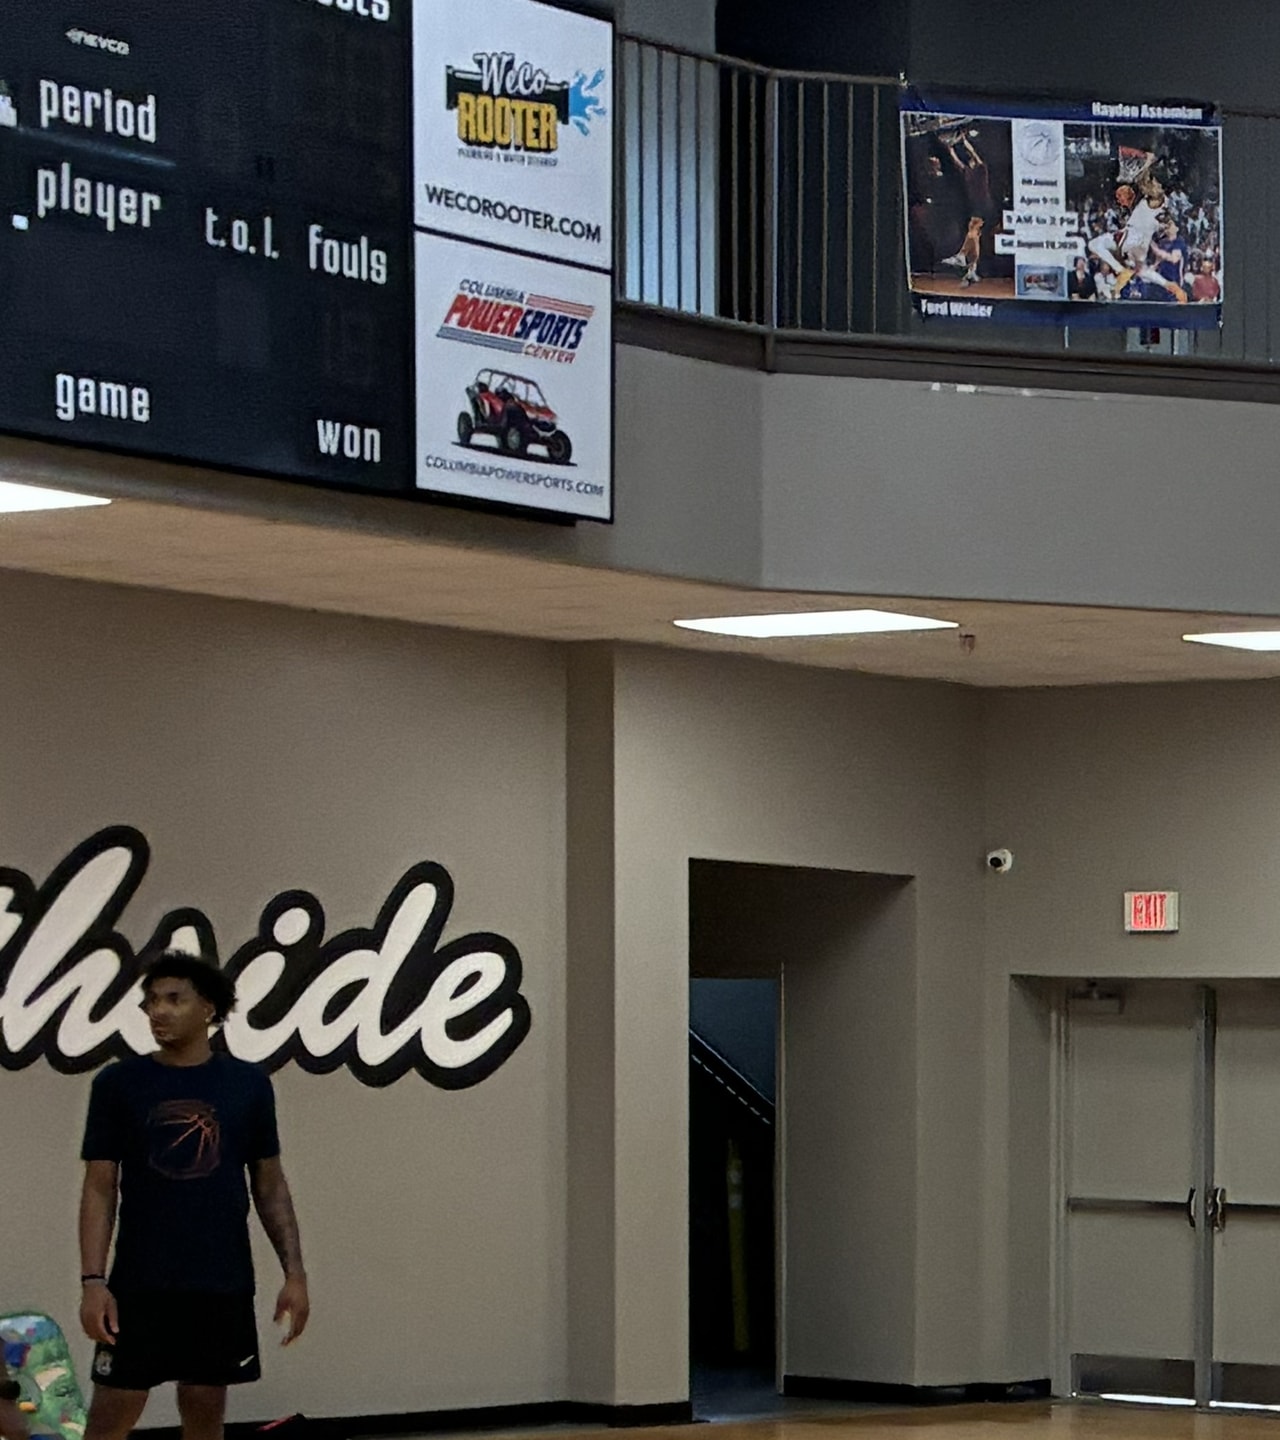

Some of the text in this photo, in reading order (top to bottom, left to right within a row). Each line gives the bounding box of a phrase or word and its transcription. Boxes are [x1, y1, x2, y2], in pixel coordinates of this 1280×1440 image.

[473, 52, 548, 95] WeCo
[39, 79, 156, 144] period
[457, 92, 558, 154] ROOTER
[37, 162, 161, 231] player
[424, 183, 602, 243] WECOROOTER.COM
[205, 206, 388, 285] t.o.l. fouls
[444, 293, 588, 350] POWERSPORTS
[525, 344, 576, 364] CENTER
[56, 373, 150, 423] game
[317, 419, 381, 462] won
[1132, 893, 1167, 929] EXIT
